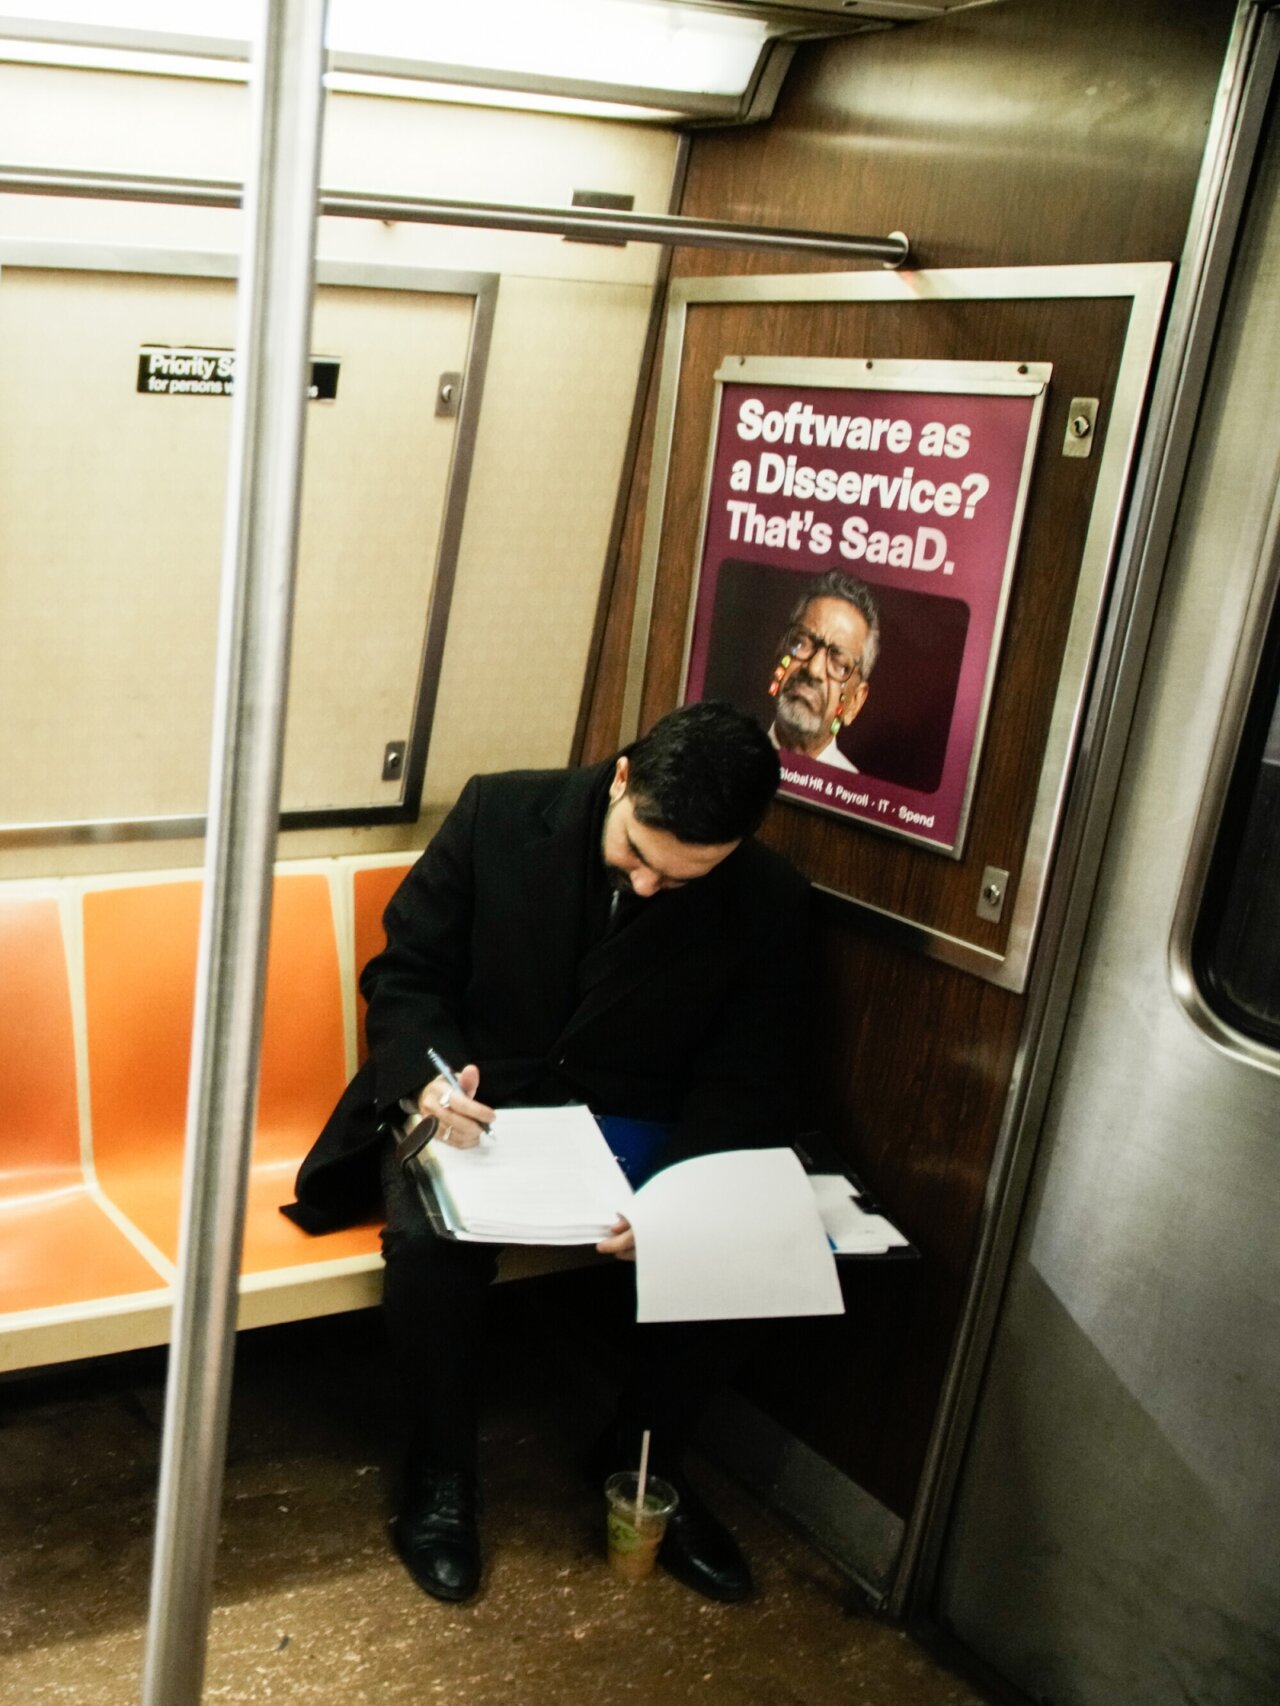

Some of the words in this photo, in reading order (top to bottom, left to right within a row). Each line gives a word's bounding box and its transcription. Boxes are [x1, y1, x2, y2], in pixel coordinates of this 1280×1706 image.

[148, 377, 168, 391] for
[170, 379, 222, 394] persons
[149, 355, 216, 379] Priority
[736, 398, 913, 454] Software
[918, 421, 972, 459] as
[729, 459, 752, 491] a
[756, 452, 990, 519] Disservice?
[726, 499, 833, 555] That's
[838, 515, 955, 575] SaaD.
[808, 776, 823, 791] HR
[825, 782, 833, 796] &
[835, 786, 869, 807] Payroll
[878, 799, 890, 813] IT
[899, 806, 934, 827] Spend
